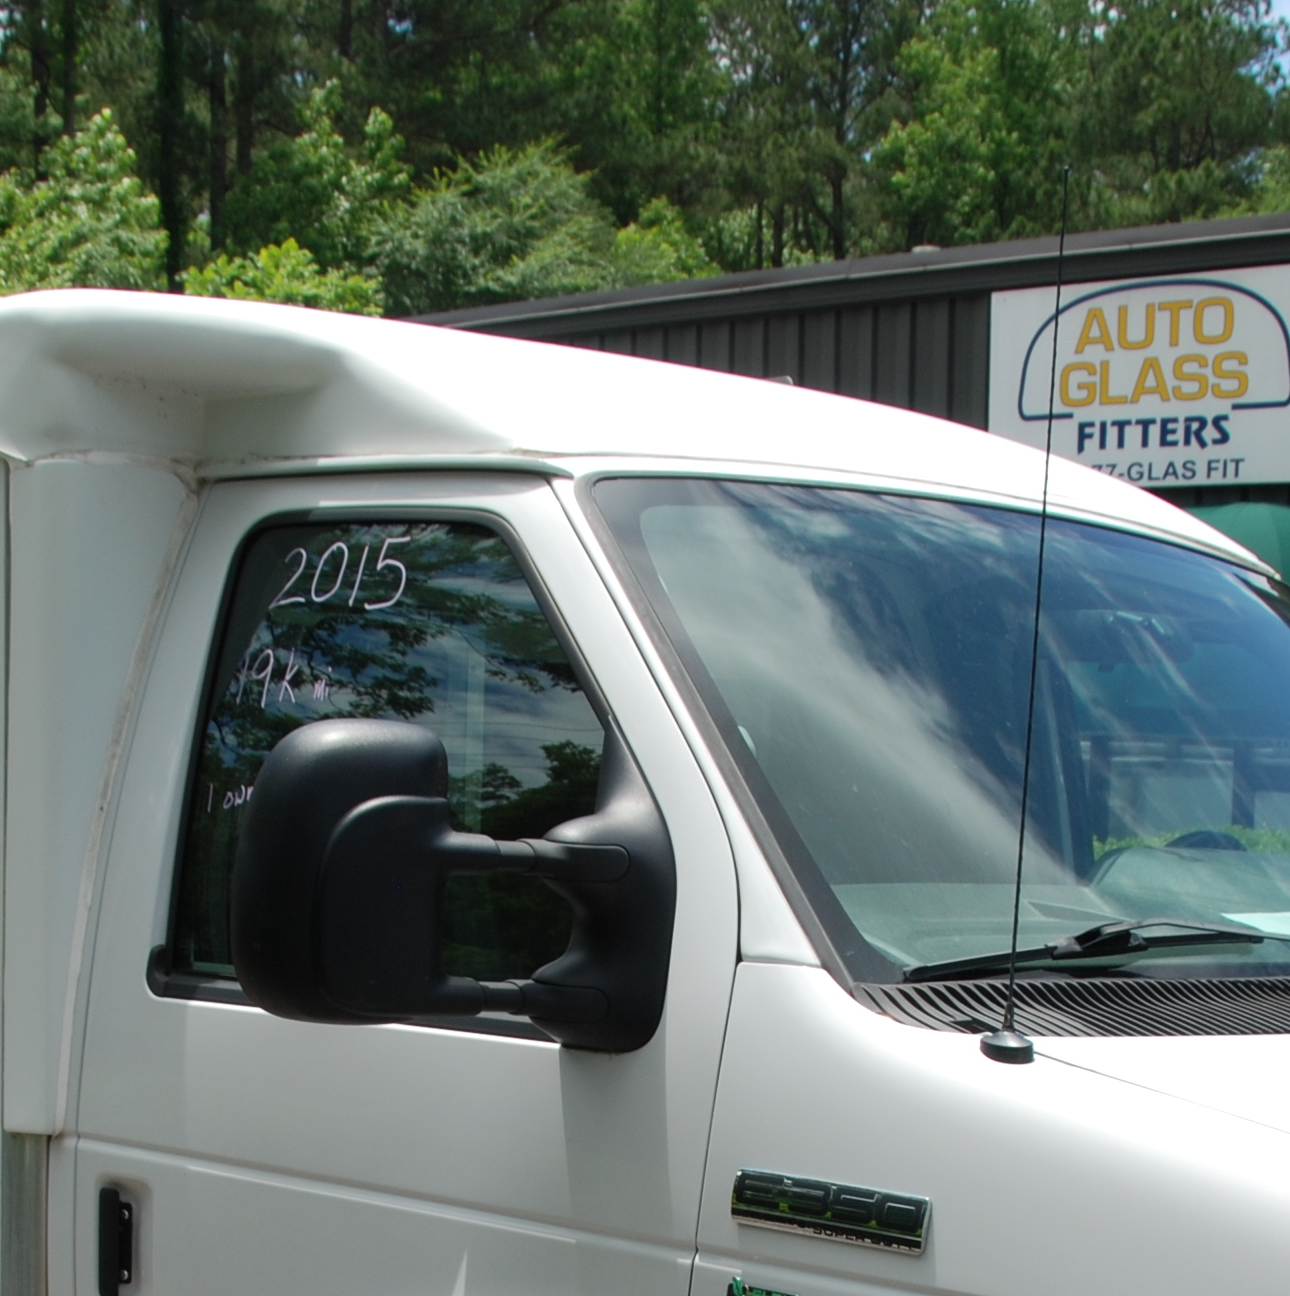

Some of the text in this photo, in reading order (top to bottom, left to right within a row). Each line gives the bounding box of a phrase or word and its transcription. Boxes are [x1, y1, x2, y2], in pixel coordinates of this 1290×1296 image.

[1074, 296, 1235, 354] AUTO
[1059, 351, 1249, 407] GLASS
[1076, 414, 1231, 455] FITTERS
[1206, 457, 1246, 480] FIT
[268, 536, 411, 610] 2015
